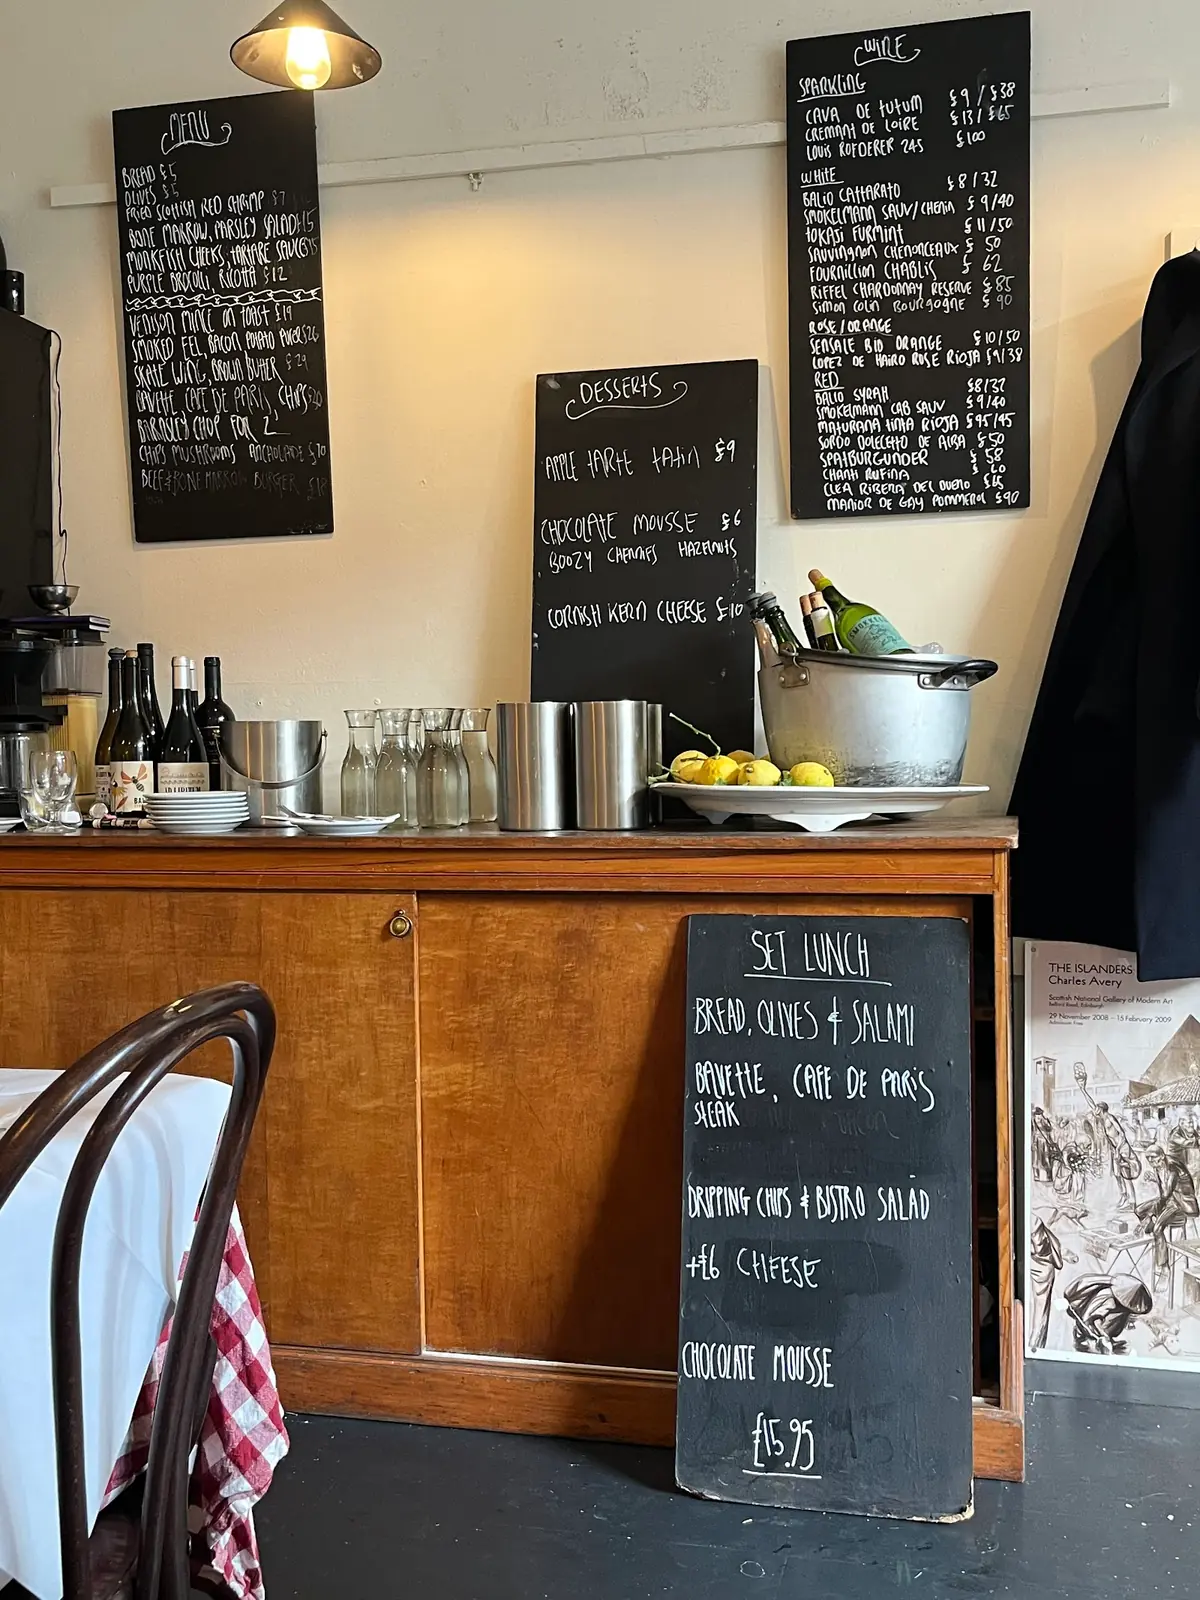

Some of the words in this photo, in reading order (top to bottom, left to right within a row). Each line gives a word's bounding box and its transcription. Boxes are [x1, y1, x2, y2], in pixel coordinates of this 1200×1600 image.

[864, 34, 906, 59] WINE
[800, 73, 866, 97] SPARKLING
[806, 108, 839, 124] CAVA
[856, 103, 870, 119] DE
[170, 110, 209, 143] MENU
[806, 124, 856, 142] CREMANT
[862, 123, 875, 135] DE
[886, 117, 919, 132] LOIRE
[807, 145, 831, 161] LOUIS
[957, 130, 986, 147] £100
[122, 165, 155, 188] BREAD
[801, 167, 836, 184] WHITE
[125, 187, 156, 206] OLIVES
[126, 205, 151, 222] FRIED
[156, 201, 197, 220] SCOTTISH
[201, 195, 222, 216] RED
[228, 190, 264, 215] SHRIMP
[129, 227, 156, 248] BONE
[215, 217, 256, 239] PARSLEY
[264, 213, 296, 240] SALAD
[852, 224, 904, 244] FURMINT
[126, 248, 186, 273] MONKFISH
[231, 240, 270, 265] TARTARE
[128, 272, 164, 293] PURPLE
[219, 268, 256, 288] RICOTTA
[264, 267, 287, 284] £12
[884, 260, 936, 281] CHABLIS
[811, 284, 847, 300] RIFFEL
[853, 282, 923, 299] CHARDONNAY
[931, 281, 972, 296] RESERVE
[813, 301, 845, 314] SIMON
[853, 300, 879, 313] COLIN
[130, 312, 176, 337] VENISON
[181, 307, 214, 335] MINCE
[223, 304, 235, 327] ON
[241, 305, 270, 328] TOAST
[276, 304, 292, 322] £19
[132, 338, 174, 364] SMOKED
[208, 332, 240, 354] BACON
[246, 329, 275, 352] POTATO
[896, 335, 942, 350] ORANGE
[134, 361, 169, 388] SKATE
[212, 358, 244, 382] BROWN
[246, 349, 283, 384] BUTTER
[812, 357, 842, 370] LOPEZ
[853, 356, 864, 367] DE
[912, 353, 940, 368] ROSE
[947, 350, 980, 367] RIOJA
[580, 372, 661, 405] DESSERTS
[814, 371, 839, 388] RED
[185, 388, 209, 413] CAFE
[212, 388, 229, 414] DE
[853, 386, 889, 402] SYRAH
[891, 401, 910, 415] CAB
[916, 400, 945, 414] SAUV
[193, 416, 221, 441] CHOP
[818, 418, 880, 435] MATURANA
[922, 414, 958, 432] RIOJA
[919, 435, 931, 447] DE
[139, 445, 166, 464] CHIPS
[172, 445, 235, 464] MUSHROOMS
[546, 451, 578, 481] APPLE
[588, 446, 633, 478] TARTE
[652, 446, 700, 474] TATIN
[715, 438, 736, 463] £9
[142, 469, 163, 489] BEEF
[913, 482, 933, 493] DEL
[880, 498, 892, 510] DE
[899, 495, 924, 512] GAY
[996, 491, 1019, 505] £90
[541, 512, 618, 545] CHOCOLATE
[633, 511, 698, 535] MOUSSE
[721, 509, 741, 531] £6
[550, 551, 592, 573] BOOZY
[548, 604, 601, 628] CORNISH
[608, 601, 646, 623] KERN
[657, 600, 706, 624] CHEESE
[716, 597, 743, 621] £10
[752, 931, 787, 975] SET
[804, 932, 869, 978] LUNCH
[1049, 963, 1071, 972] THE
[1075, 964, 1133, 974] ISLANDERS
[1049, 975, 1086, 985] Charles
[1089, 977, 1122, 988] Avery
[1103, 996, 1125, 1004] Gallery
[757, 1000, 818, 1039] OLIVES
[851, 1000, 914, 1046] SALAMI
[793, 1063, 832, 1100] CAFE
[847, 1066, 867, 1099] DE
[881, 1066, 935, 1112] PARIS
[695, 1100, 740, 1128] STEAK
[688, 1185, 750, 1219] DRIPPING
[757, 1187, 791, 1219] CHIPS
[816, 1185, 865, 1222] BISTRO
[878, 1187, 929, 1222] SALAD
[737, 1248, 821, 1289] CHEESE
[682, 1341, 755, 1381] CHOCOLATE
[774, 1345, 834, 1387] MOUSSE
[752, 1412, 814, 1470] £15.95
